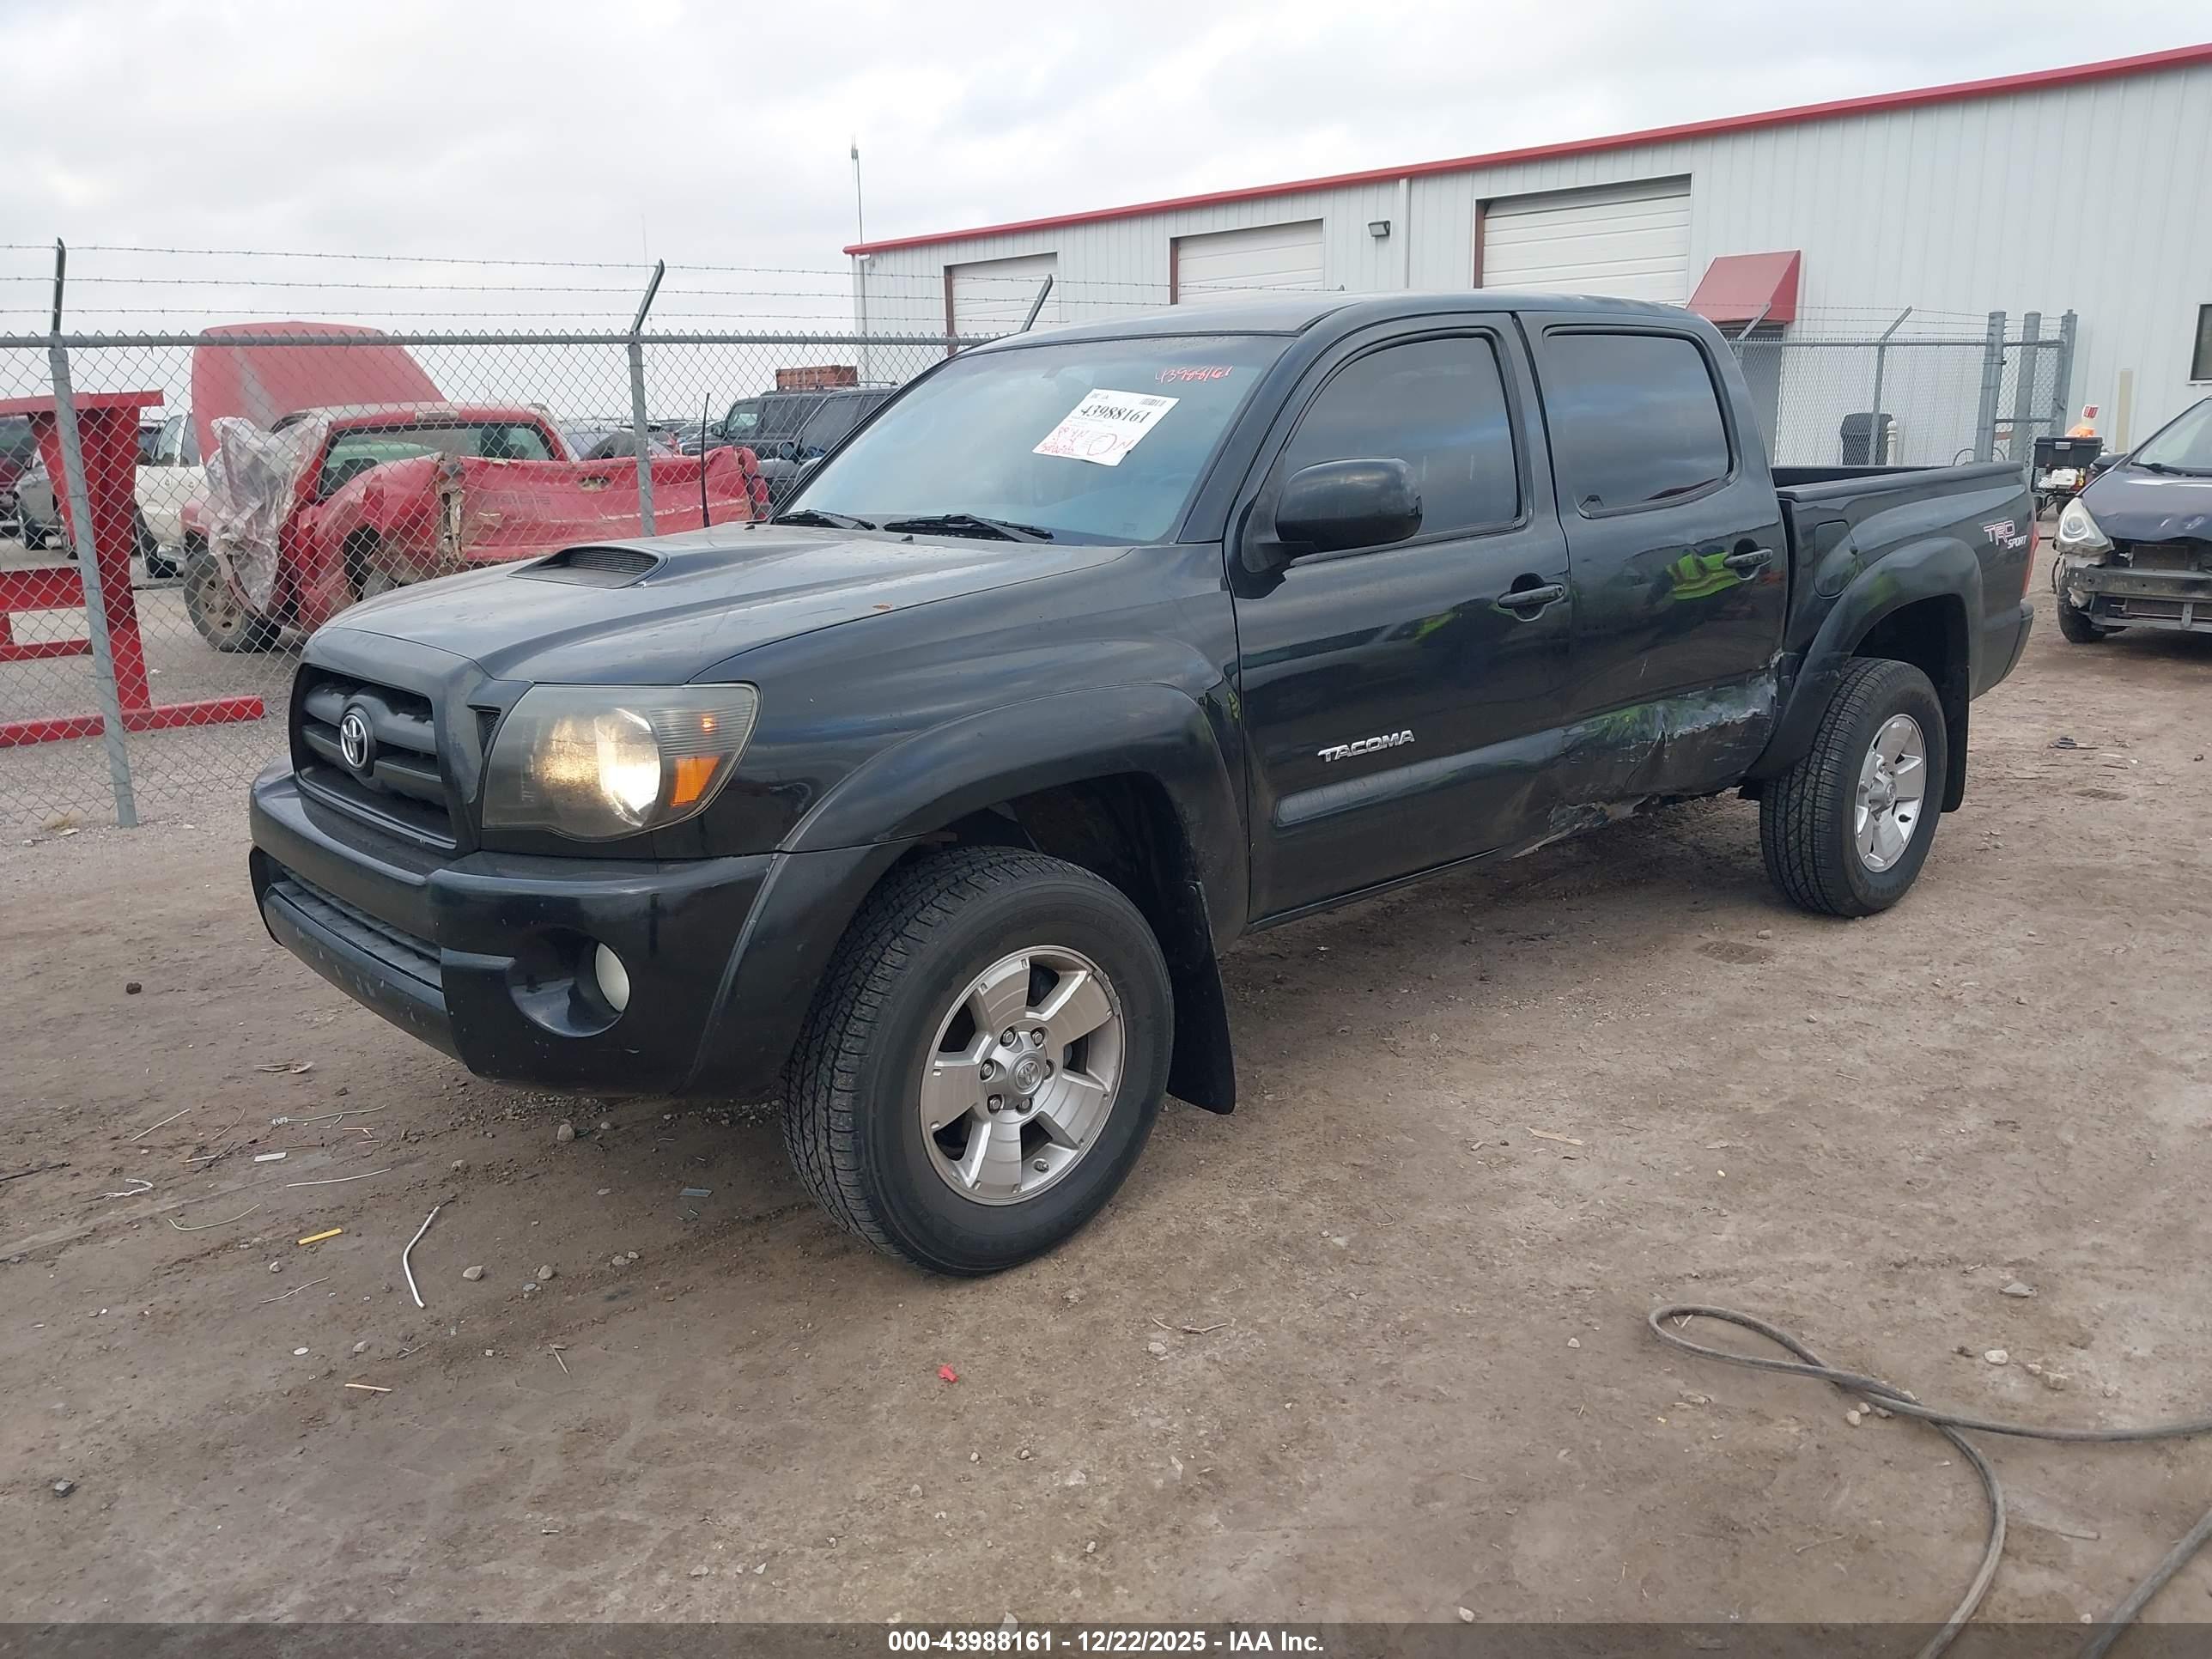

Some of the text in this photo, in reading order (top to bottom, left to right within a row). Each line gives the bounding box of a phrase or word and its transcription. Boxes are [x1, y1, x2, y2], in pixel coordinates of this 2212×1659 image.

[1155, 366, 1233, 383] 43988161
[1080, 404, 1152, 423] 43988161
[1983, 520, 2015, 545] TRD
[2008, 535, 2027, 549] SPORT
[1317, 730, 1415, 762] TACOMA
